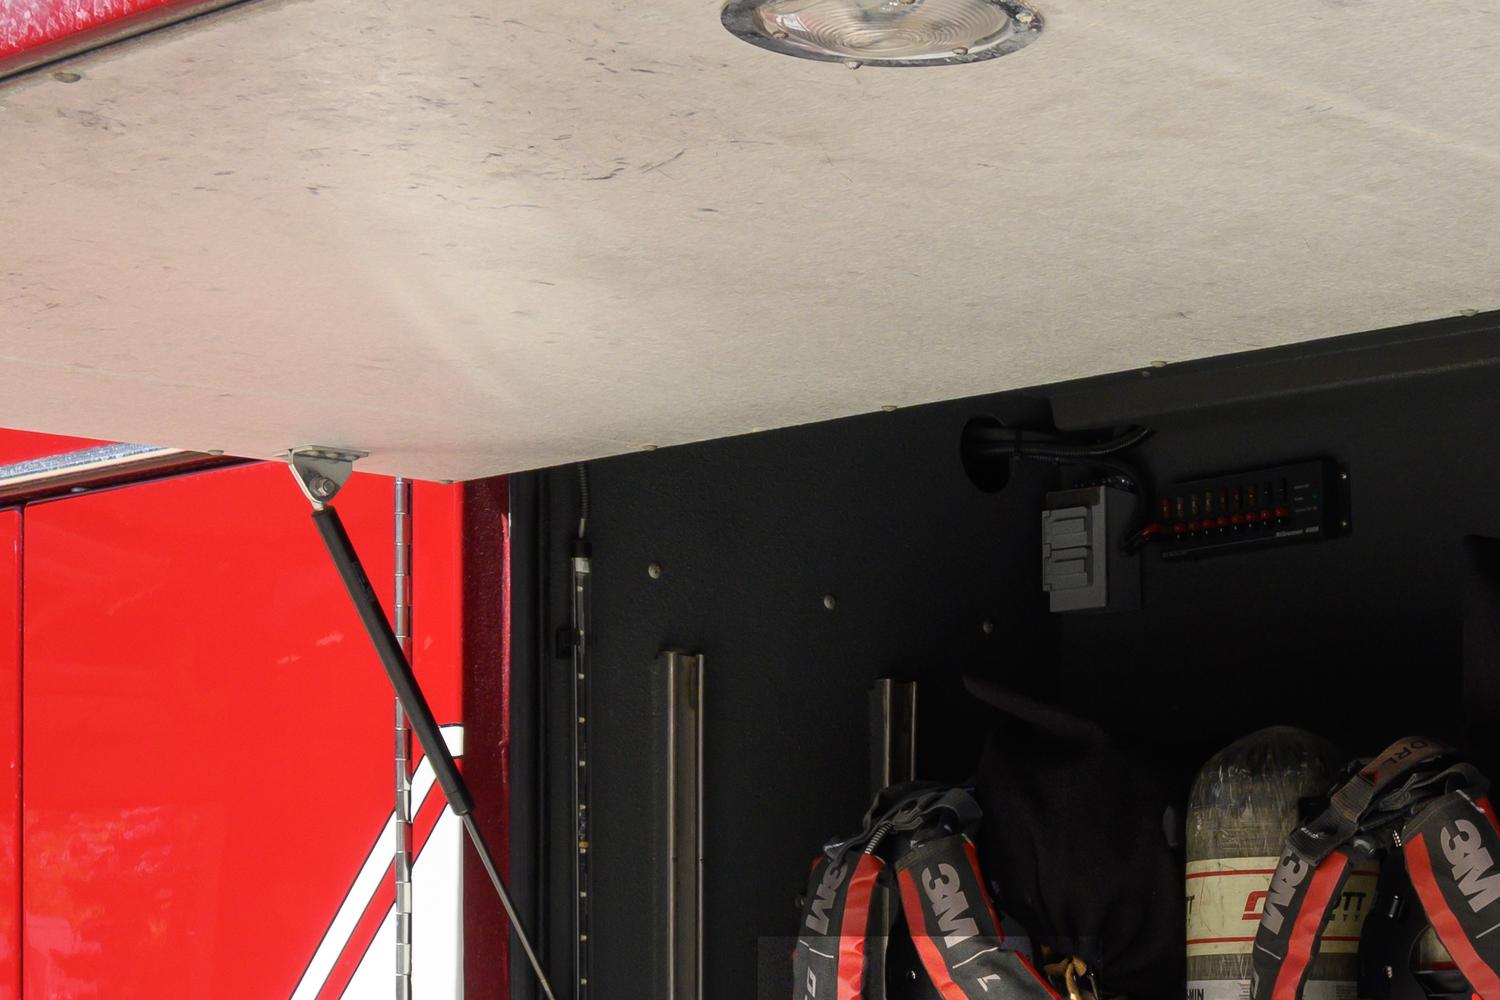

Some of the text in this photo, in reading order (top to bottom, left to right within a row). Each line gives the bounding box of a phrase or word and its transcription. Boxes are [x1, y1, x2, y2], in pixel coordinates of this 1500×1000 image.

[804, 859, 849, 936] 3M
[921, 863, 980, 949] 3M
[1259, 845, 1310, 936] 3M
